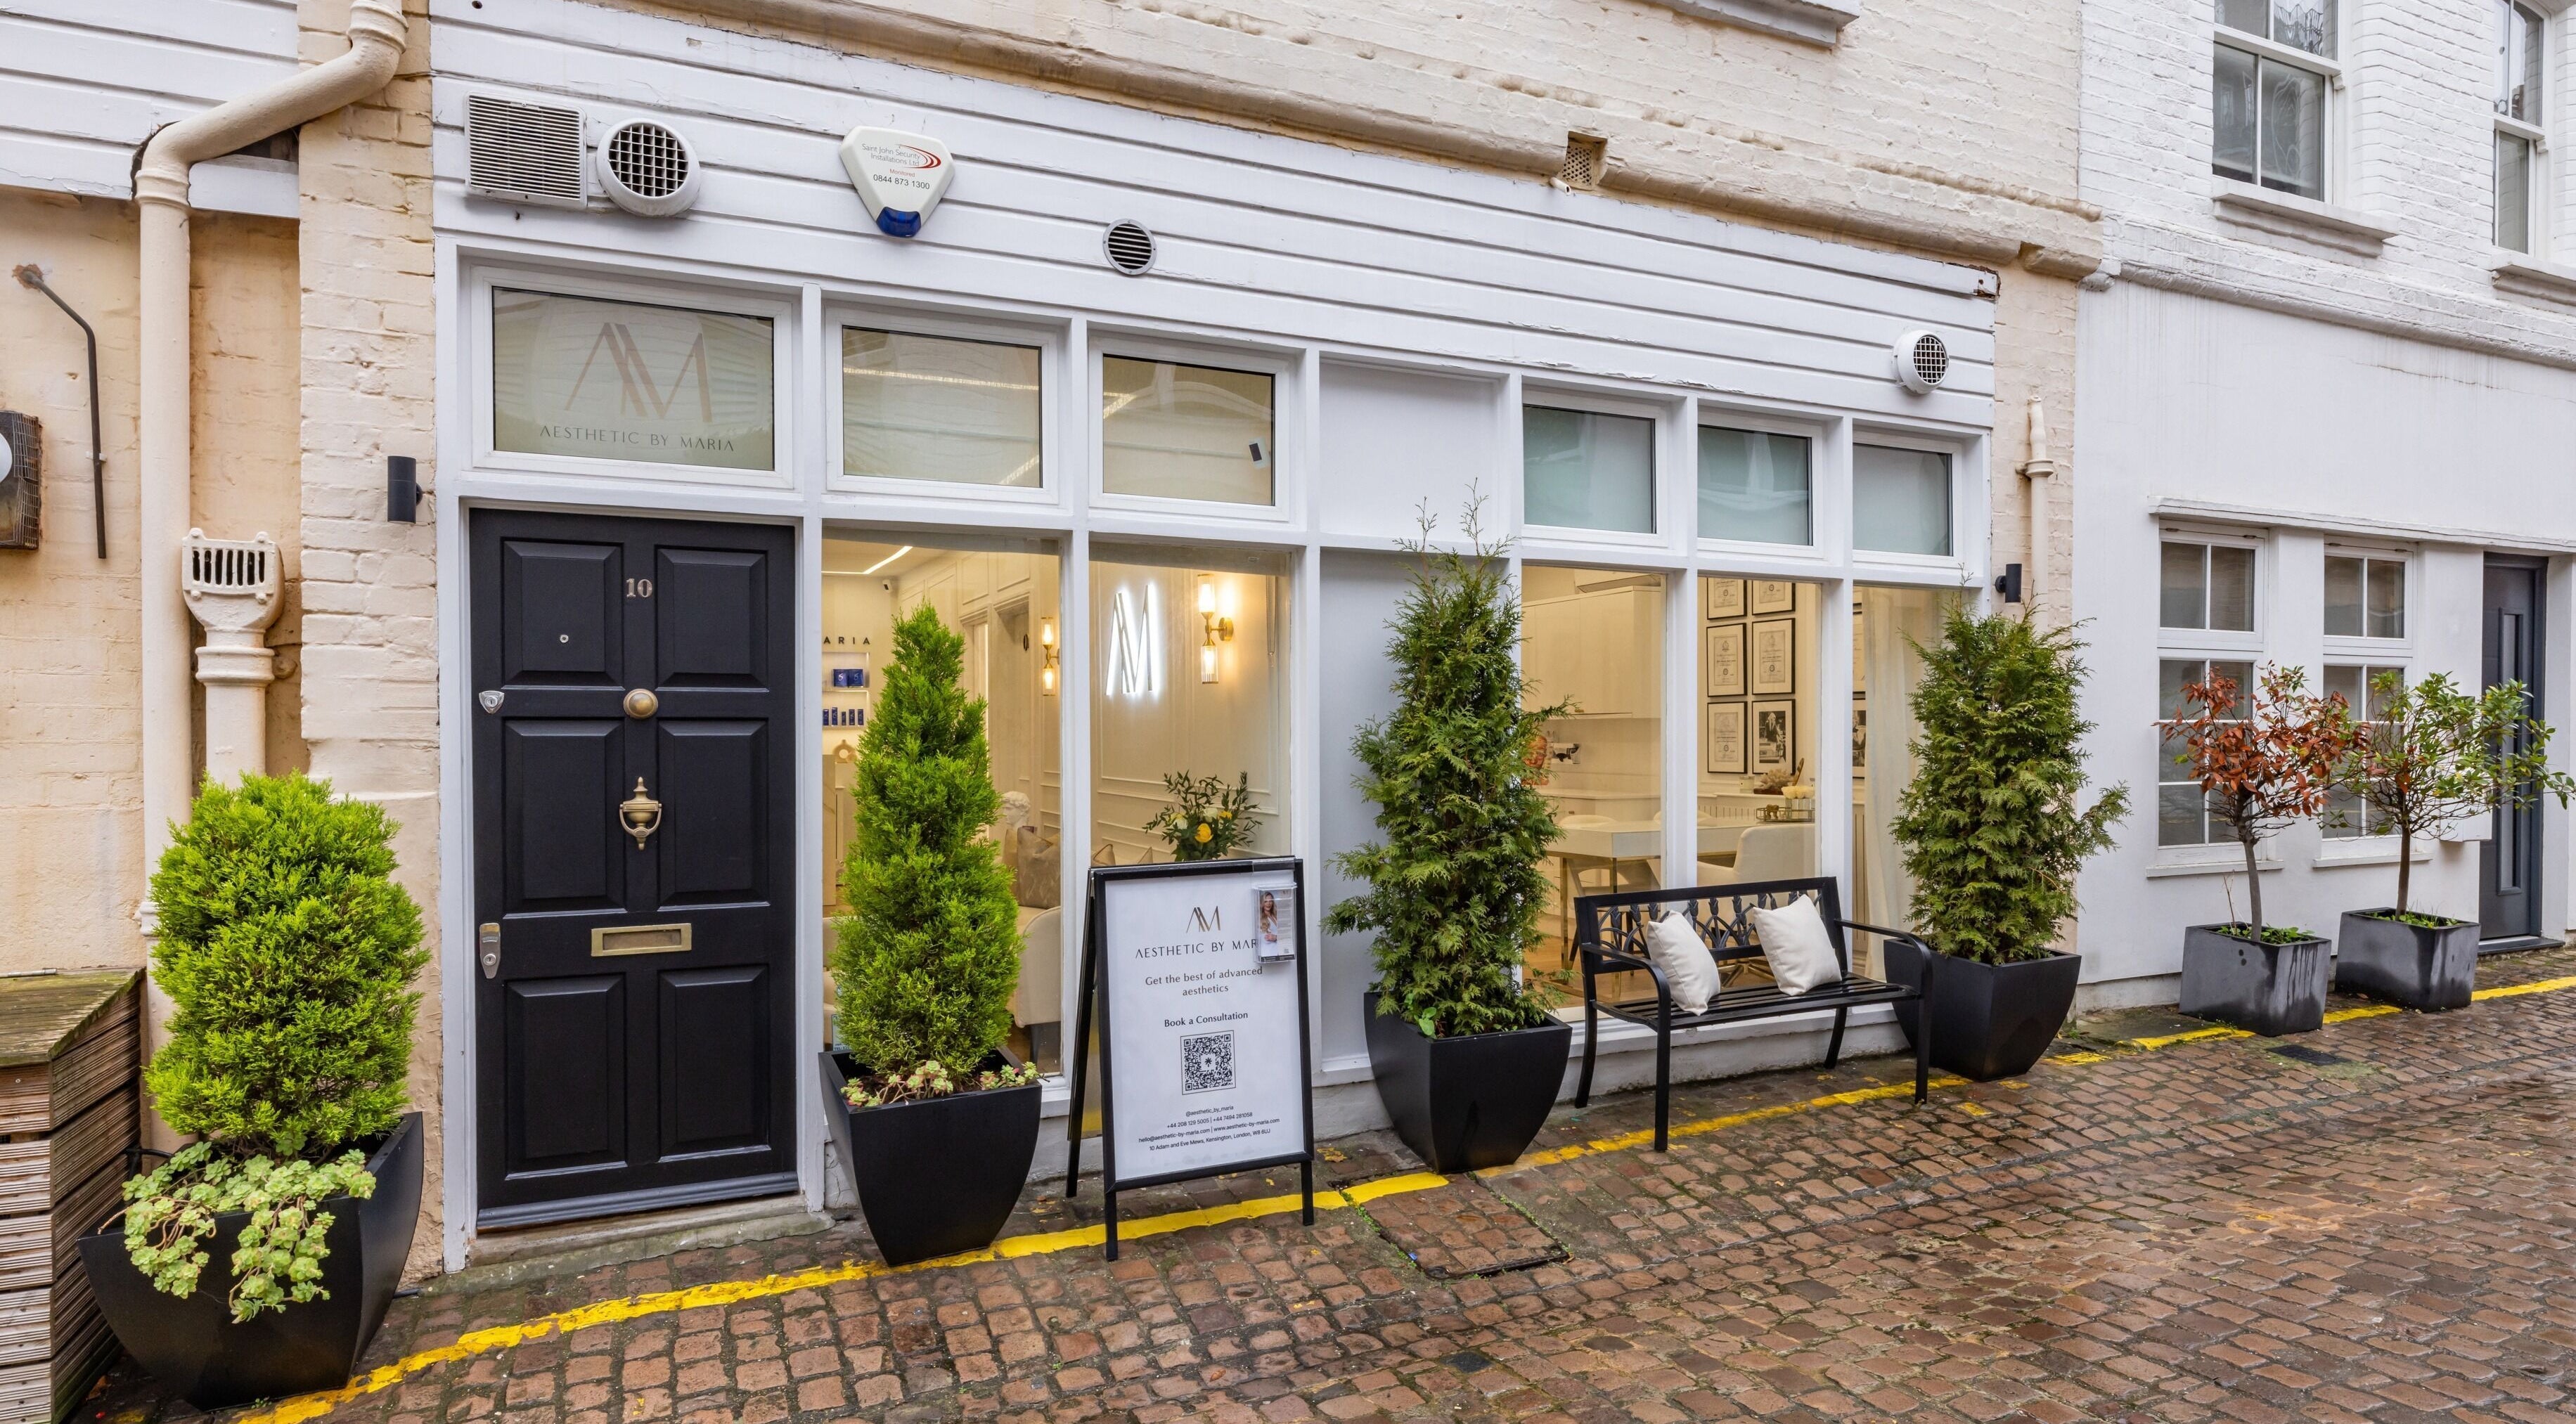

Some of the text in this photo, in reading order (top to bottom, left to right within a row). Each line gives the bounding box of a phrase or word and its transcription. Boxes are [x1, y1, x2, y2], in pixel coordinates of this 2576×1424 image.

[862, 143, 920, 160] Saint John Security
[870, 153, 907, 166] Installations
[889, 169, 915, 178] Monitored
[873, 174, 930, 190] 0844 873 1300
[539, 425, 734, 452] AESTHETIC BY MARIA
[626, 578, 653, 598] 10
[823, 636, 870, 645] ARIA
[1135, 938, 1258, 959] AESTHETIC BY MAR
[1145, 965, 1263, 985] Get the best of advanced
[1182, 984, 1230, 997] aesthetics
[1164, 1017, 1186, 1028] Book
[1196, 1011, 1249, 1024] Consultation
[1185, 1105, 1234, 1118] @aesthetic_by_maria
[1138, 1128, 1211, 1143] hello@aesthetic-by-maria.com
[1214, 1118, 1280, 1132] www.aesthetic-by-maria.com
[1206, 1134, 1233, 1143] Kensington,
